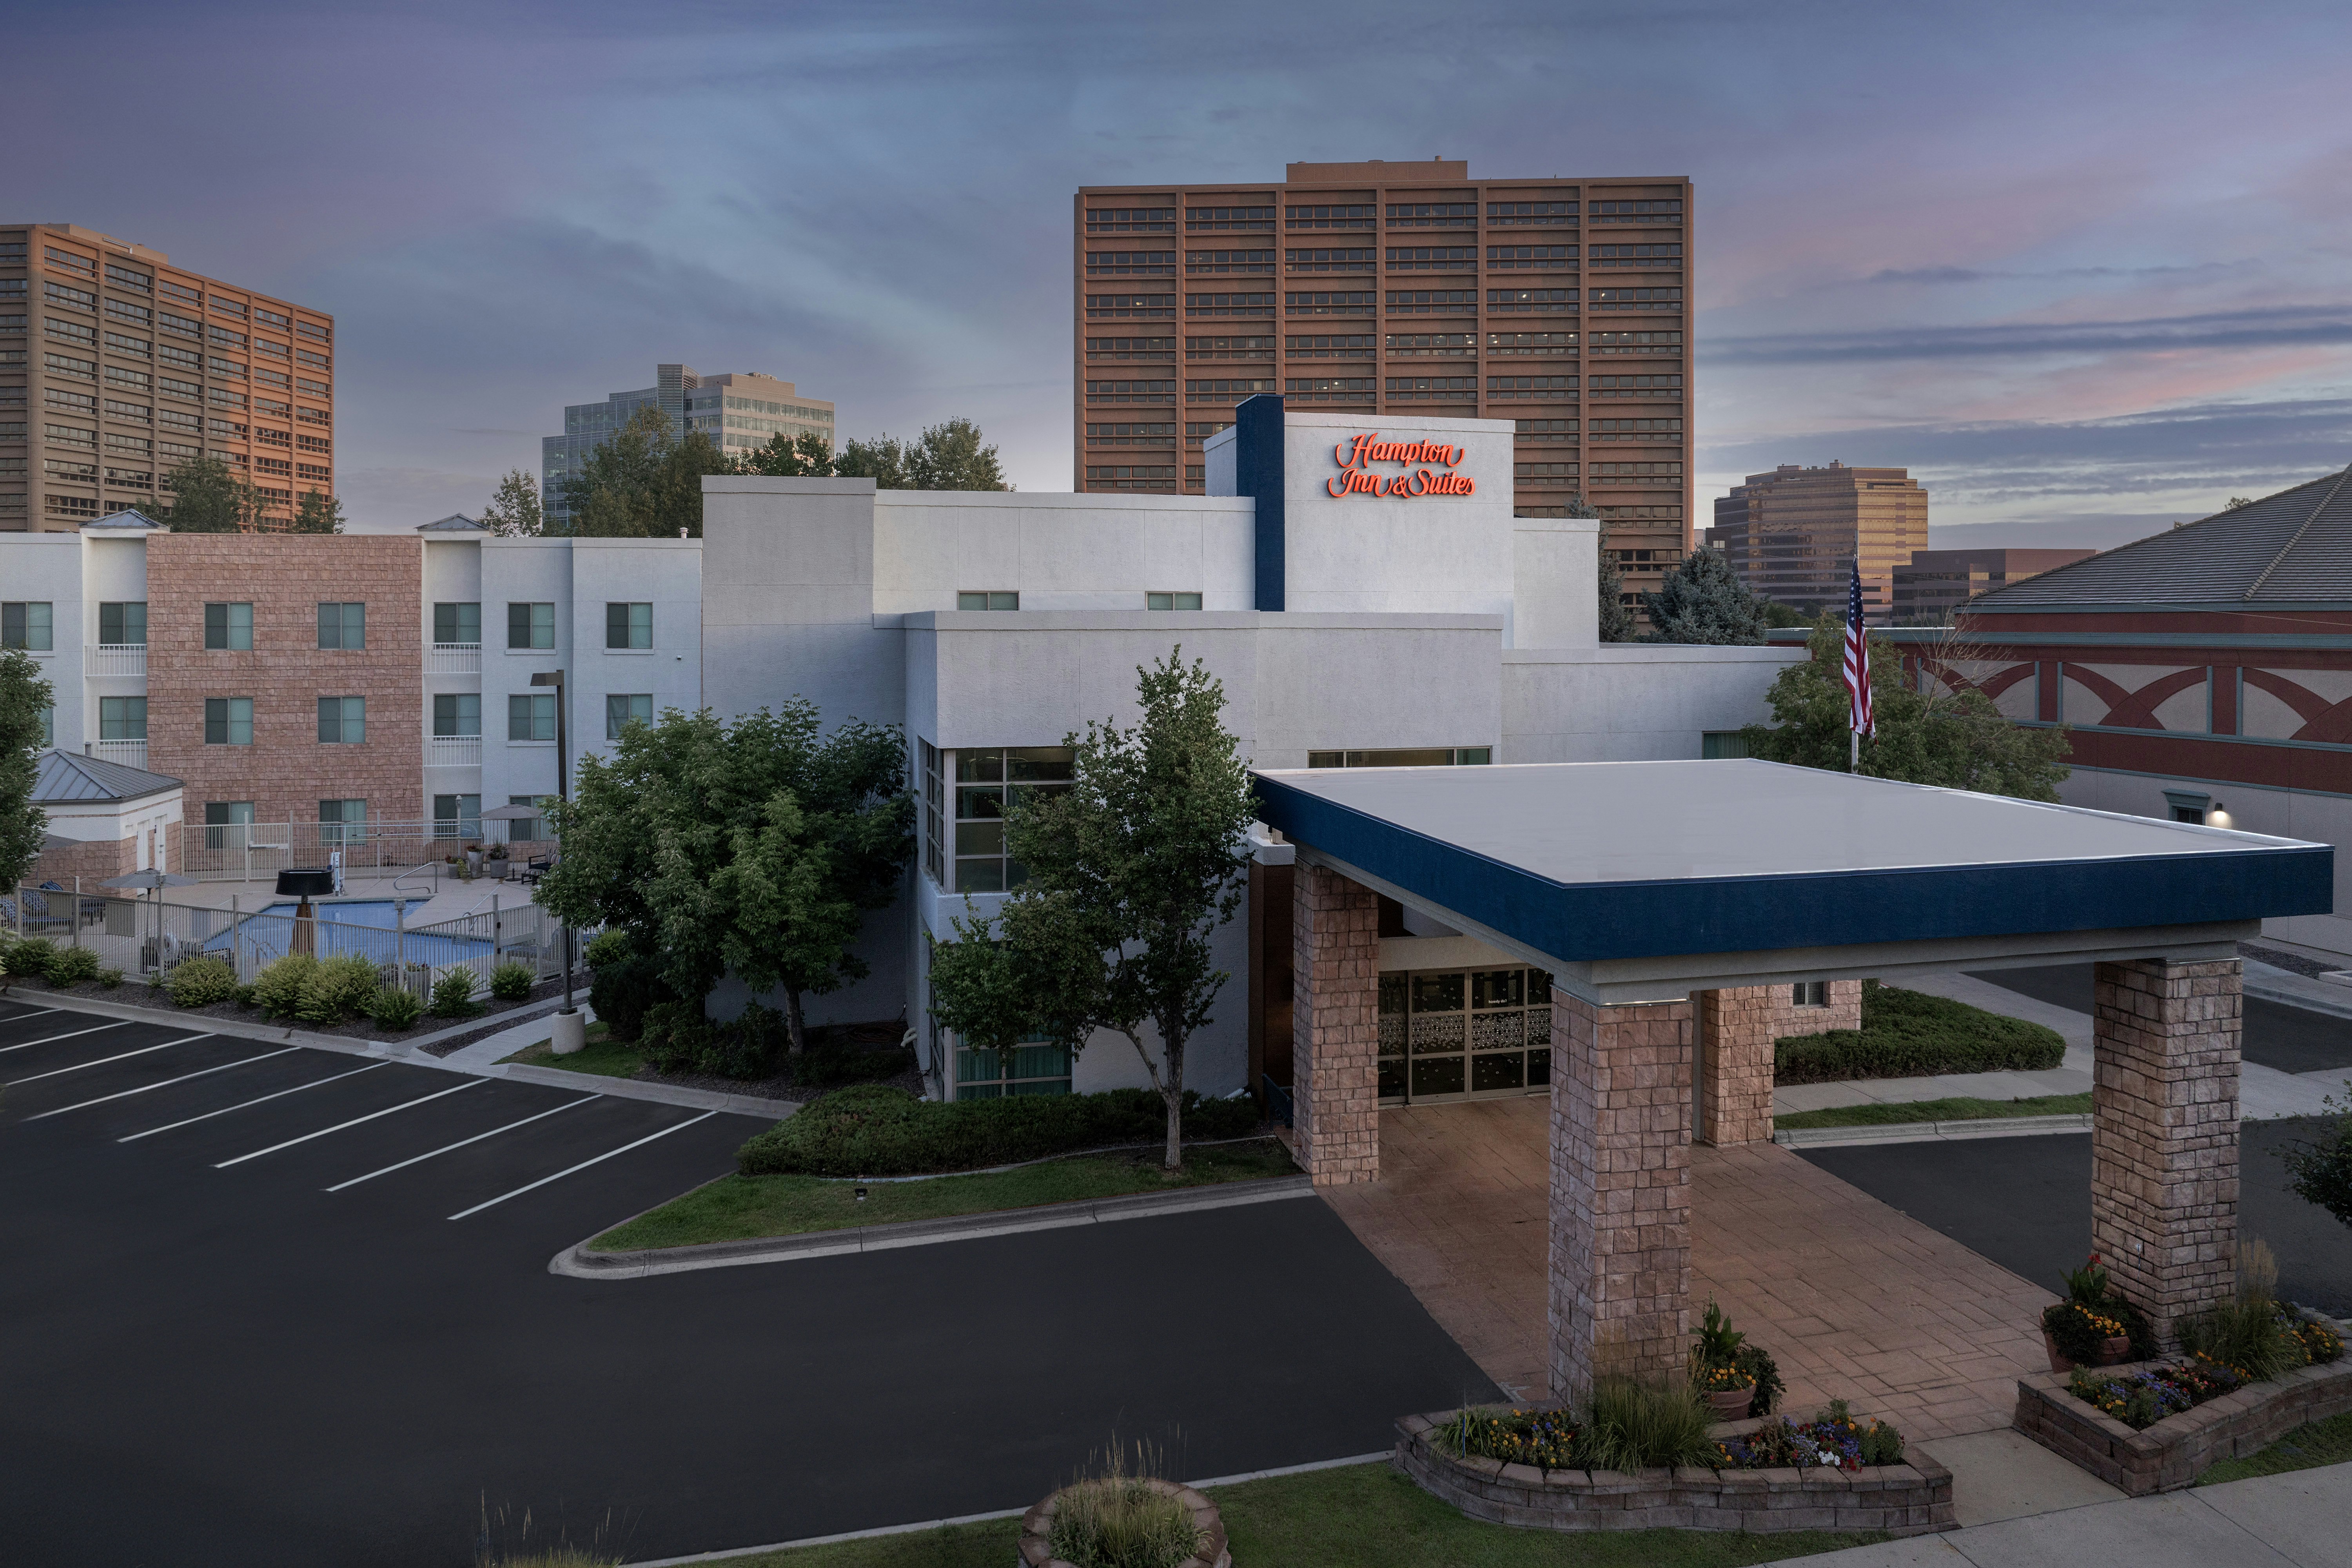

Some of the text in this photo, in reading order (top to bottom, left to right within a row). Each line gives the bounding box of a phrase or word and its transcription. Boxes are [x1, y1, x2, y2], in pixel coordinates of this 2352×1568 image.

[1336, 432, 1465, 468] Hampton
[1327, 468, 1476, 498] Inn & Suites
